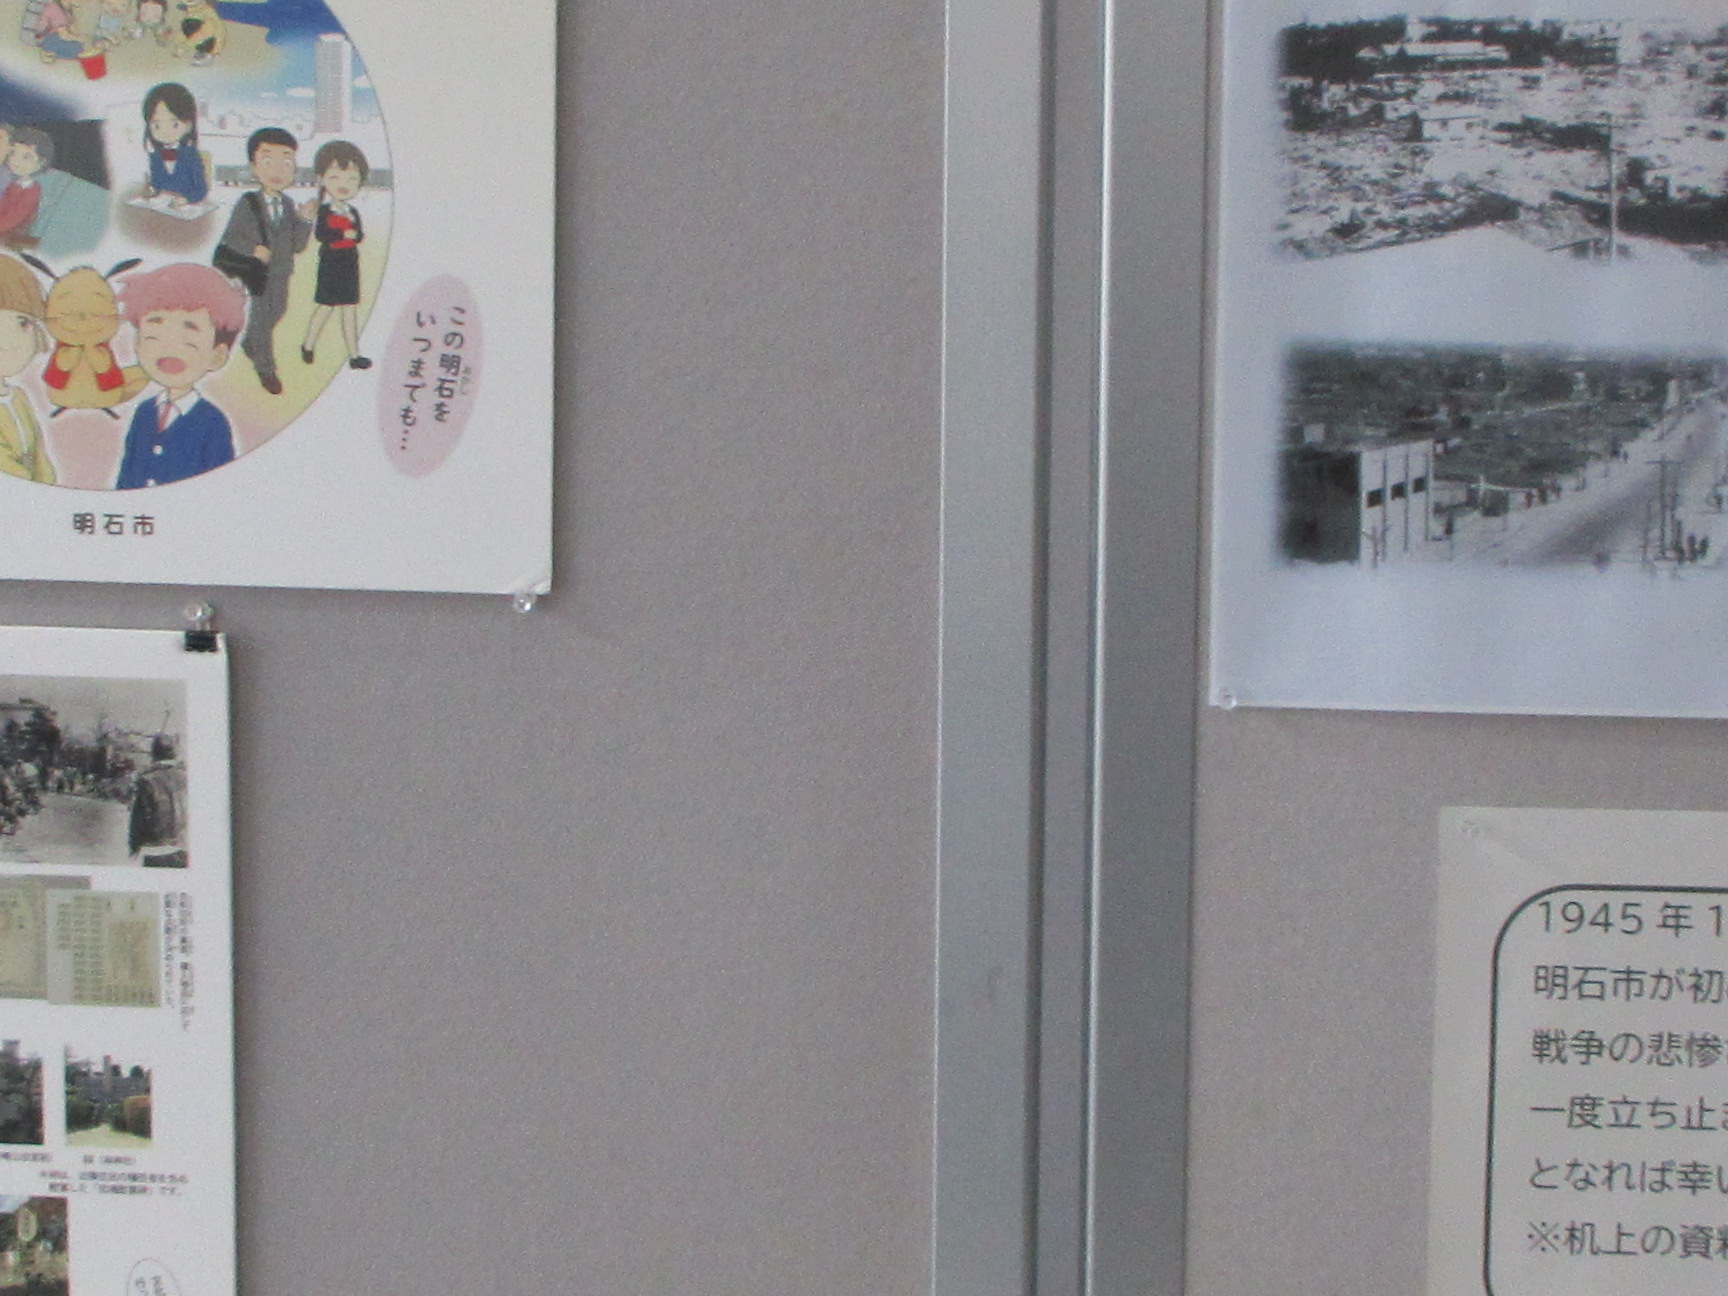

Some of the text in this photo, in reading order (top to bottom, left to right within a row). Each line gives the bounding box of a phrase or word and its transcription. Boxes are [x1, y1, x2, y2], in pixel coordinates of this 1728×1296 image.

[433, 304, 468, 424] この明石を
[73, 512, 156, 538] 明石市
